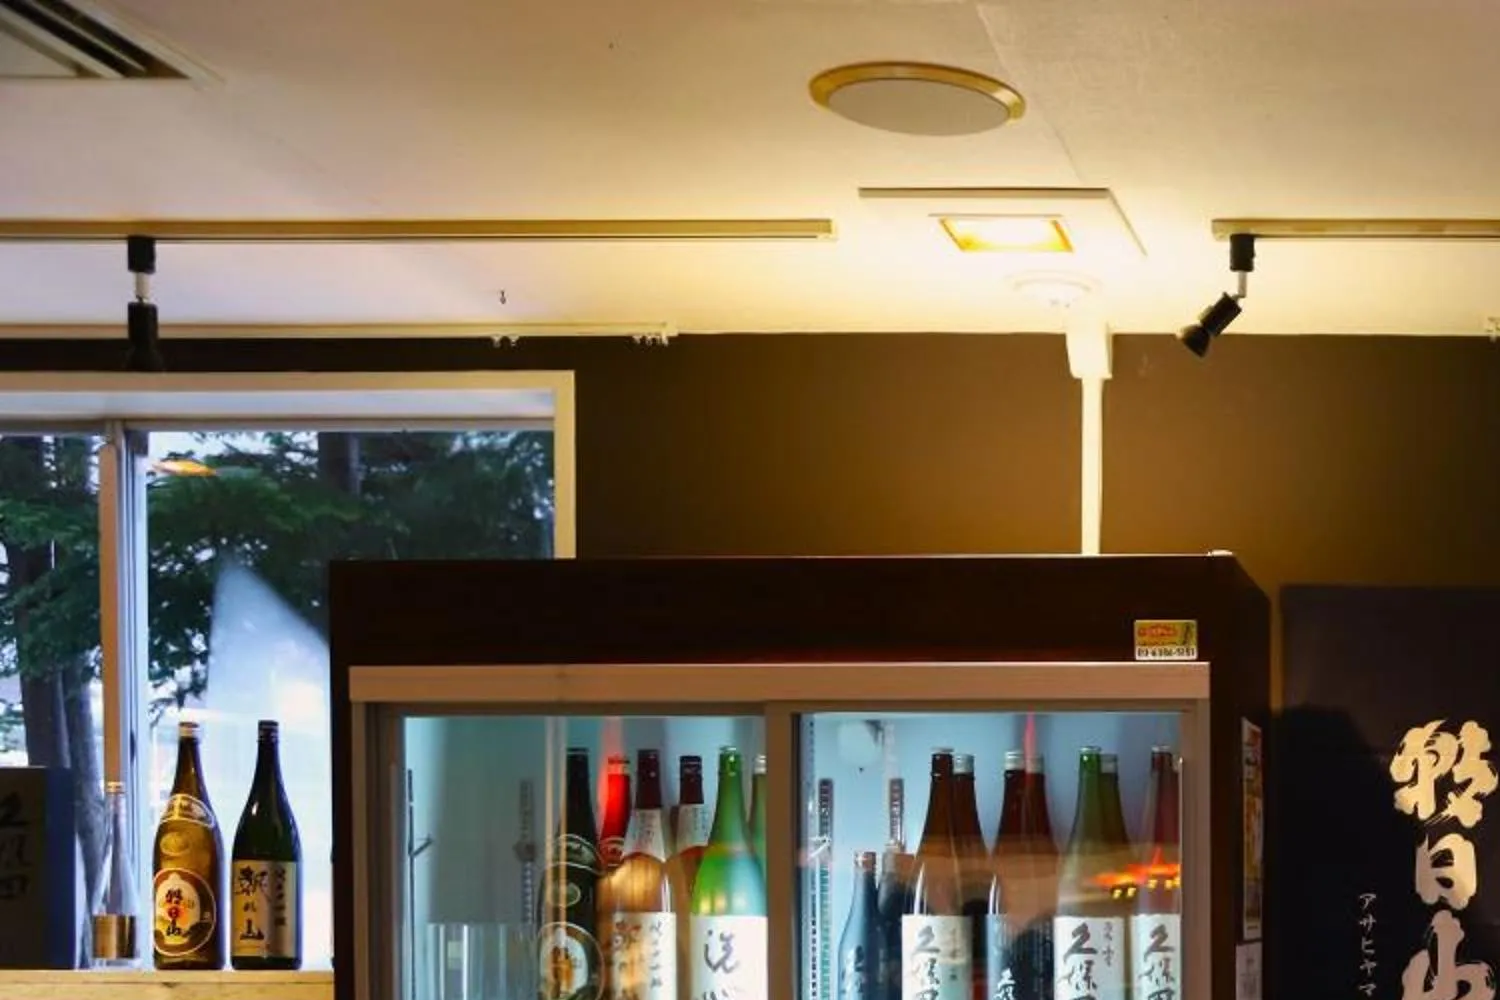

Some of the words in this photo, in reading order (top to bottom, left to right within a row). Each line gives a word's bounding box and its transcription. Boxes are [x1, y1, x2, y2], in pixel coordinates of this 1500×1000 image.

[1359, 893, 1377, 997] アサヒヤマ
